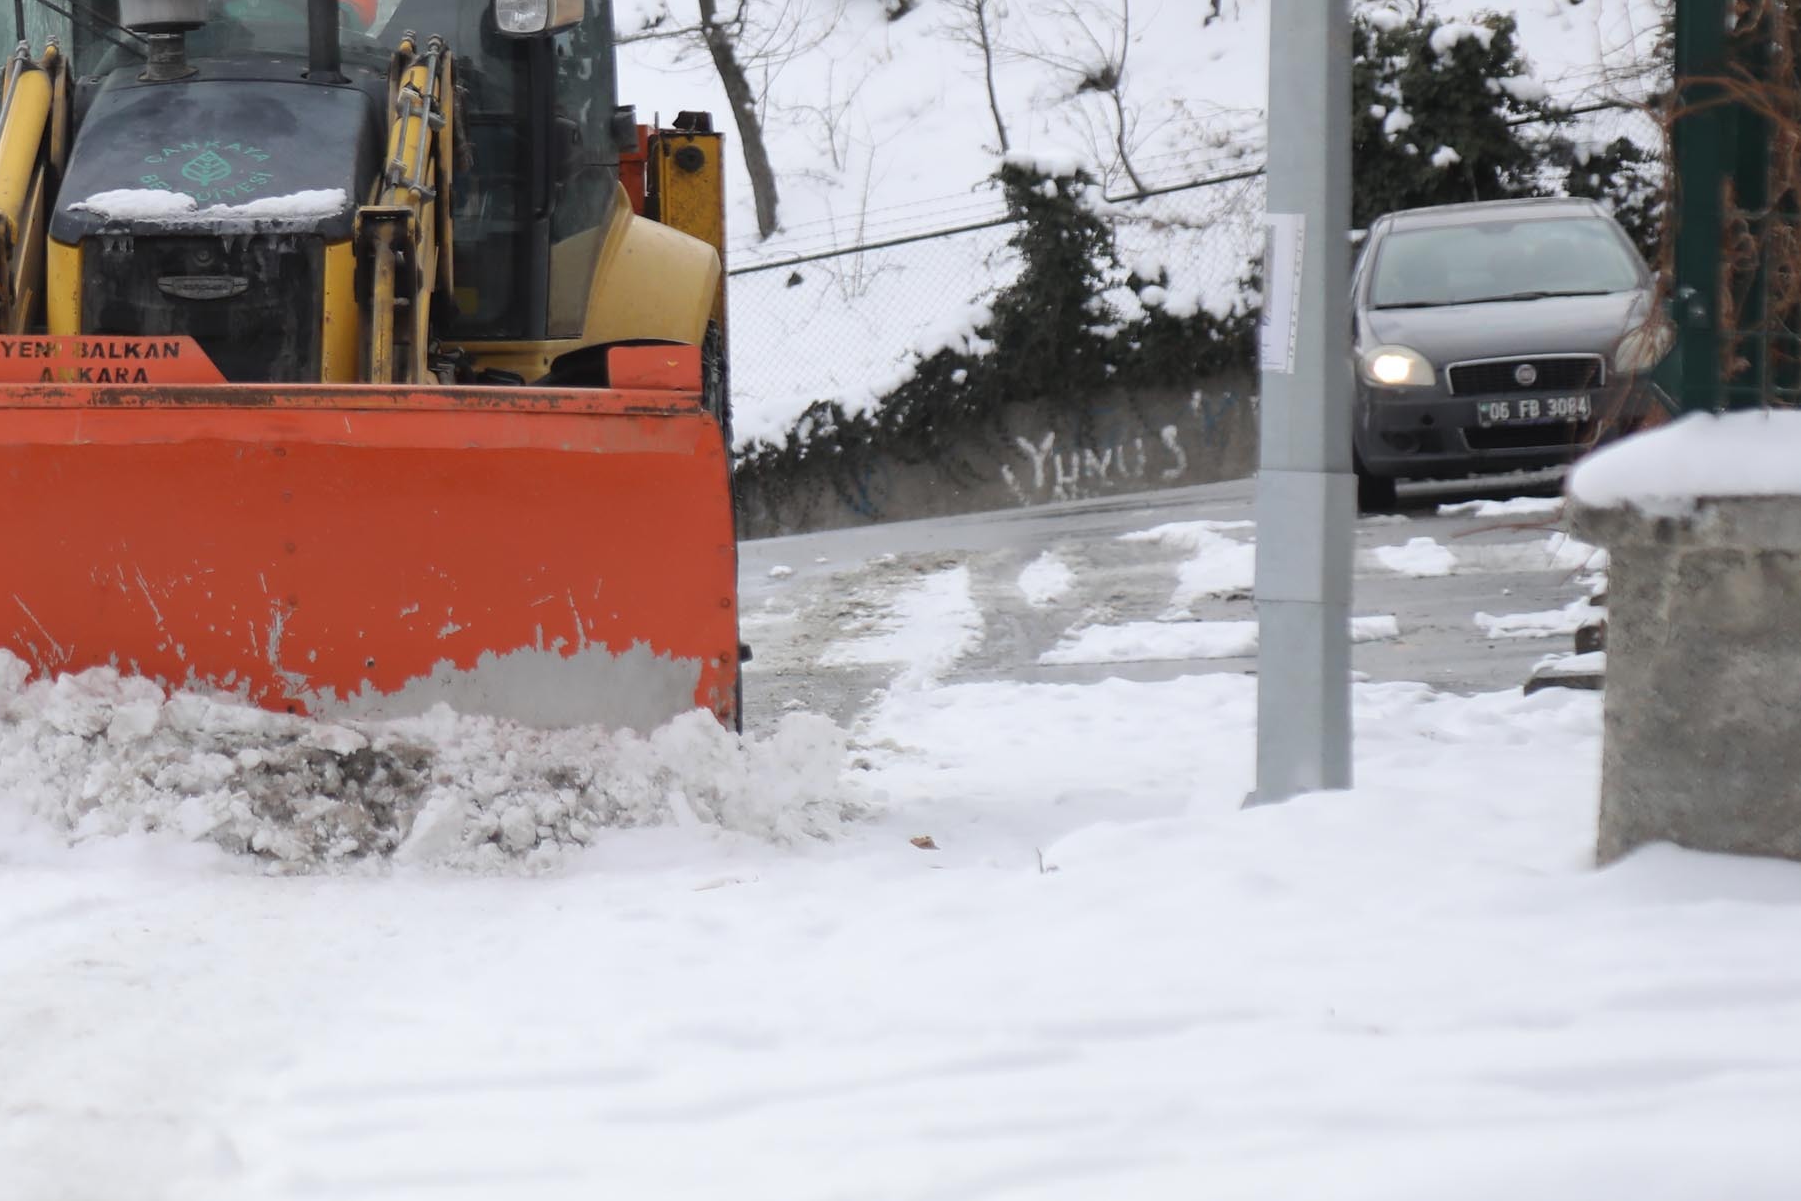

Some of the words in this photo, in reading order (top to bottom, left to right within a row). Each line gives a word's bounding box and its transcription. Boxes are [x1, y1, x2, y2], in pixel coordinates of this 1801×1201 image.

[72, 342, 180, 359] BALKAN
[39, 366, 149, 383] ANKARA
[1519, 399, 1540, 418] FB
